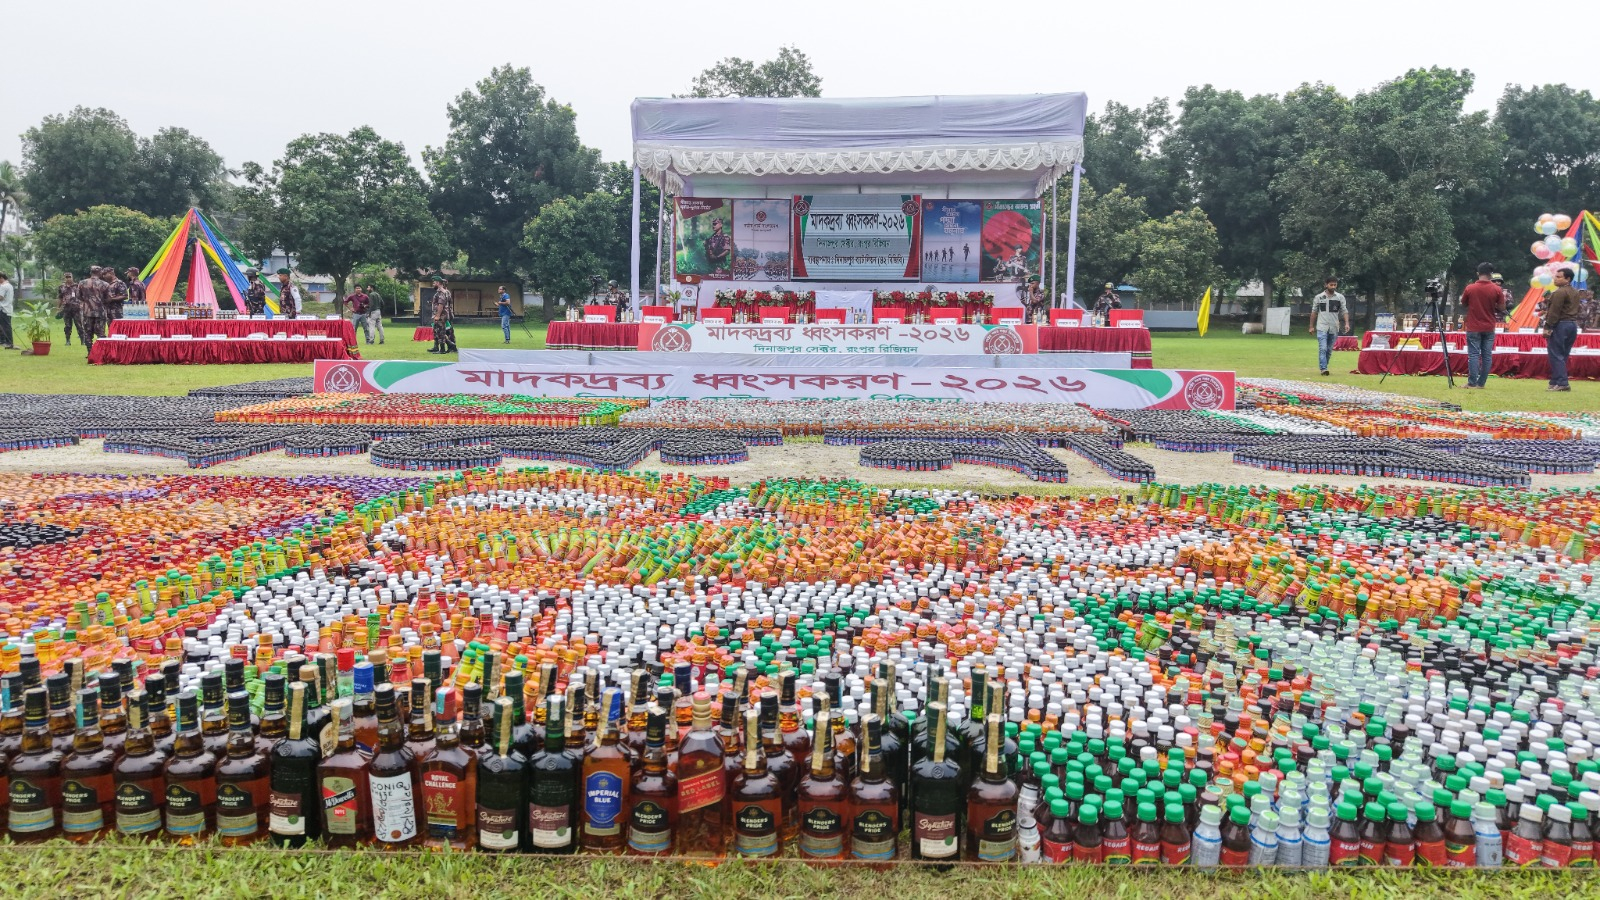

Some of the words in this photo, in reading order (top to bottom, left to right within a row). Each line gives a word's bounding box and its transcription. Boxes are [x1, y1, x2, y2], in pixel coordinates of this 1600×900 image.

[810, 213, 843, 231] মাদকদ্রব্য
[817, 238, 838, 249] দিনাজপুর
[859, 240, 871, 249] রংপুর
[706, 326, 795, 342] মাদকদ্রব্য
[802, 325, 893, 342] ধ্বংসকরণ
[753, 343, 802, 353] দিনাজপুর
[846, 345, 875, 353] রংপুর
[879, 343, 918, 353] রিজিয়ন
[456, 369, 674, 391] মাদকদ্রব্য
[692, 372, 907, 392] ধ্বংসকরণ
[940, 374, 1087, 394] ২০২৬
[424, 780, 457, 789] CHALLENGE
[430, 774, 449, 782] ROYAL
[588, 789, 619, 798] IMPERIAL
[681, 788, 695, 797] RED
[697, 780, 720, 792] LABEL
[479, 811, 513, 824] Signature
[532, 809, 566, 822] Signature
[635, 811, 662, 819] BLENDERS
[919, 818, 954, 831] Signature
